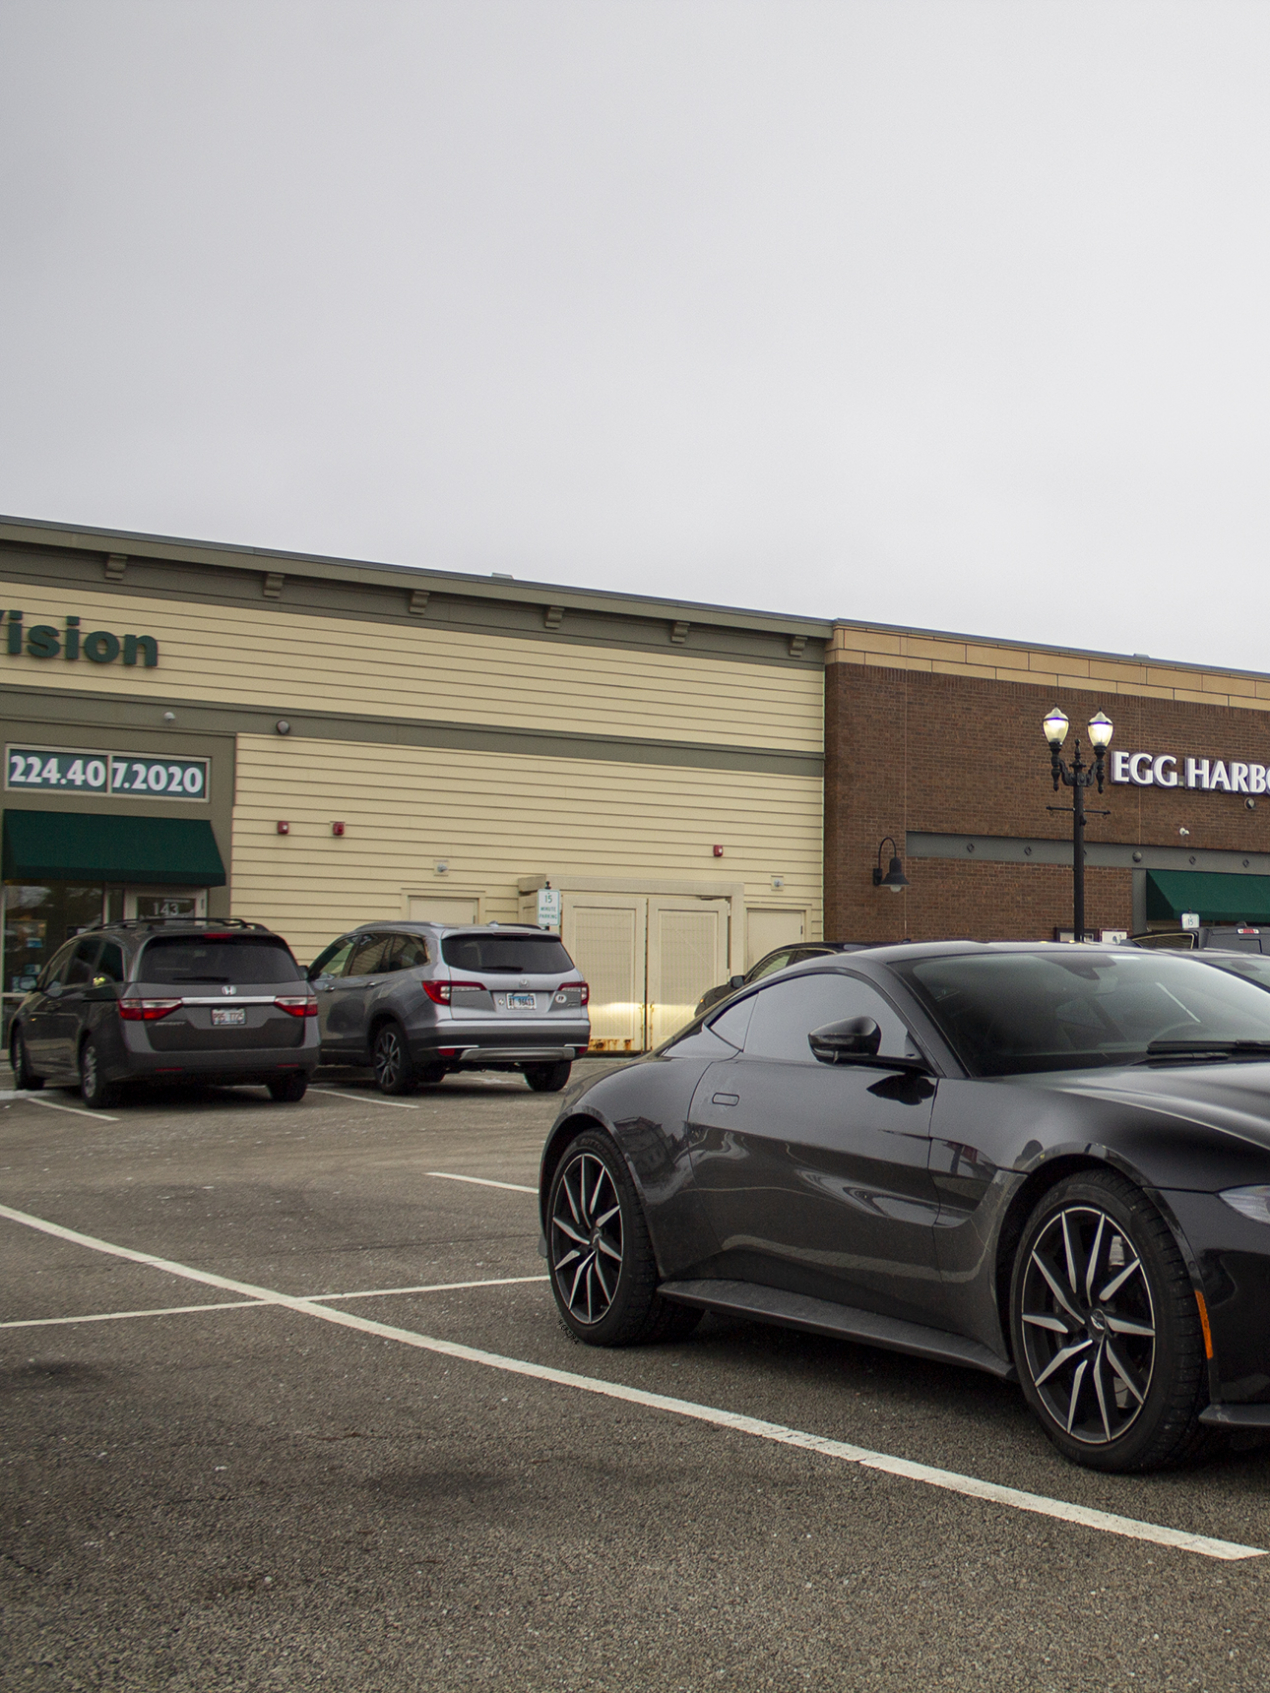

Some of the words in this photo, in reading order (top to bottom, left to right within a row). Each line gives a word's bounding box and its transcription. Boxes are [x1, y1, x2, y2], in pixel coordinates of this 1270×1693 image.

[0, 609, 159, 667] ision
[10, 755, 203, 793] 224.407.2020
[1112, 751, 1178, 787] EGG
[153, 902, 180, 916] 143
[544, 894, 553, 904] 15
[1187, 917, 1194, 926] 15
